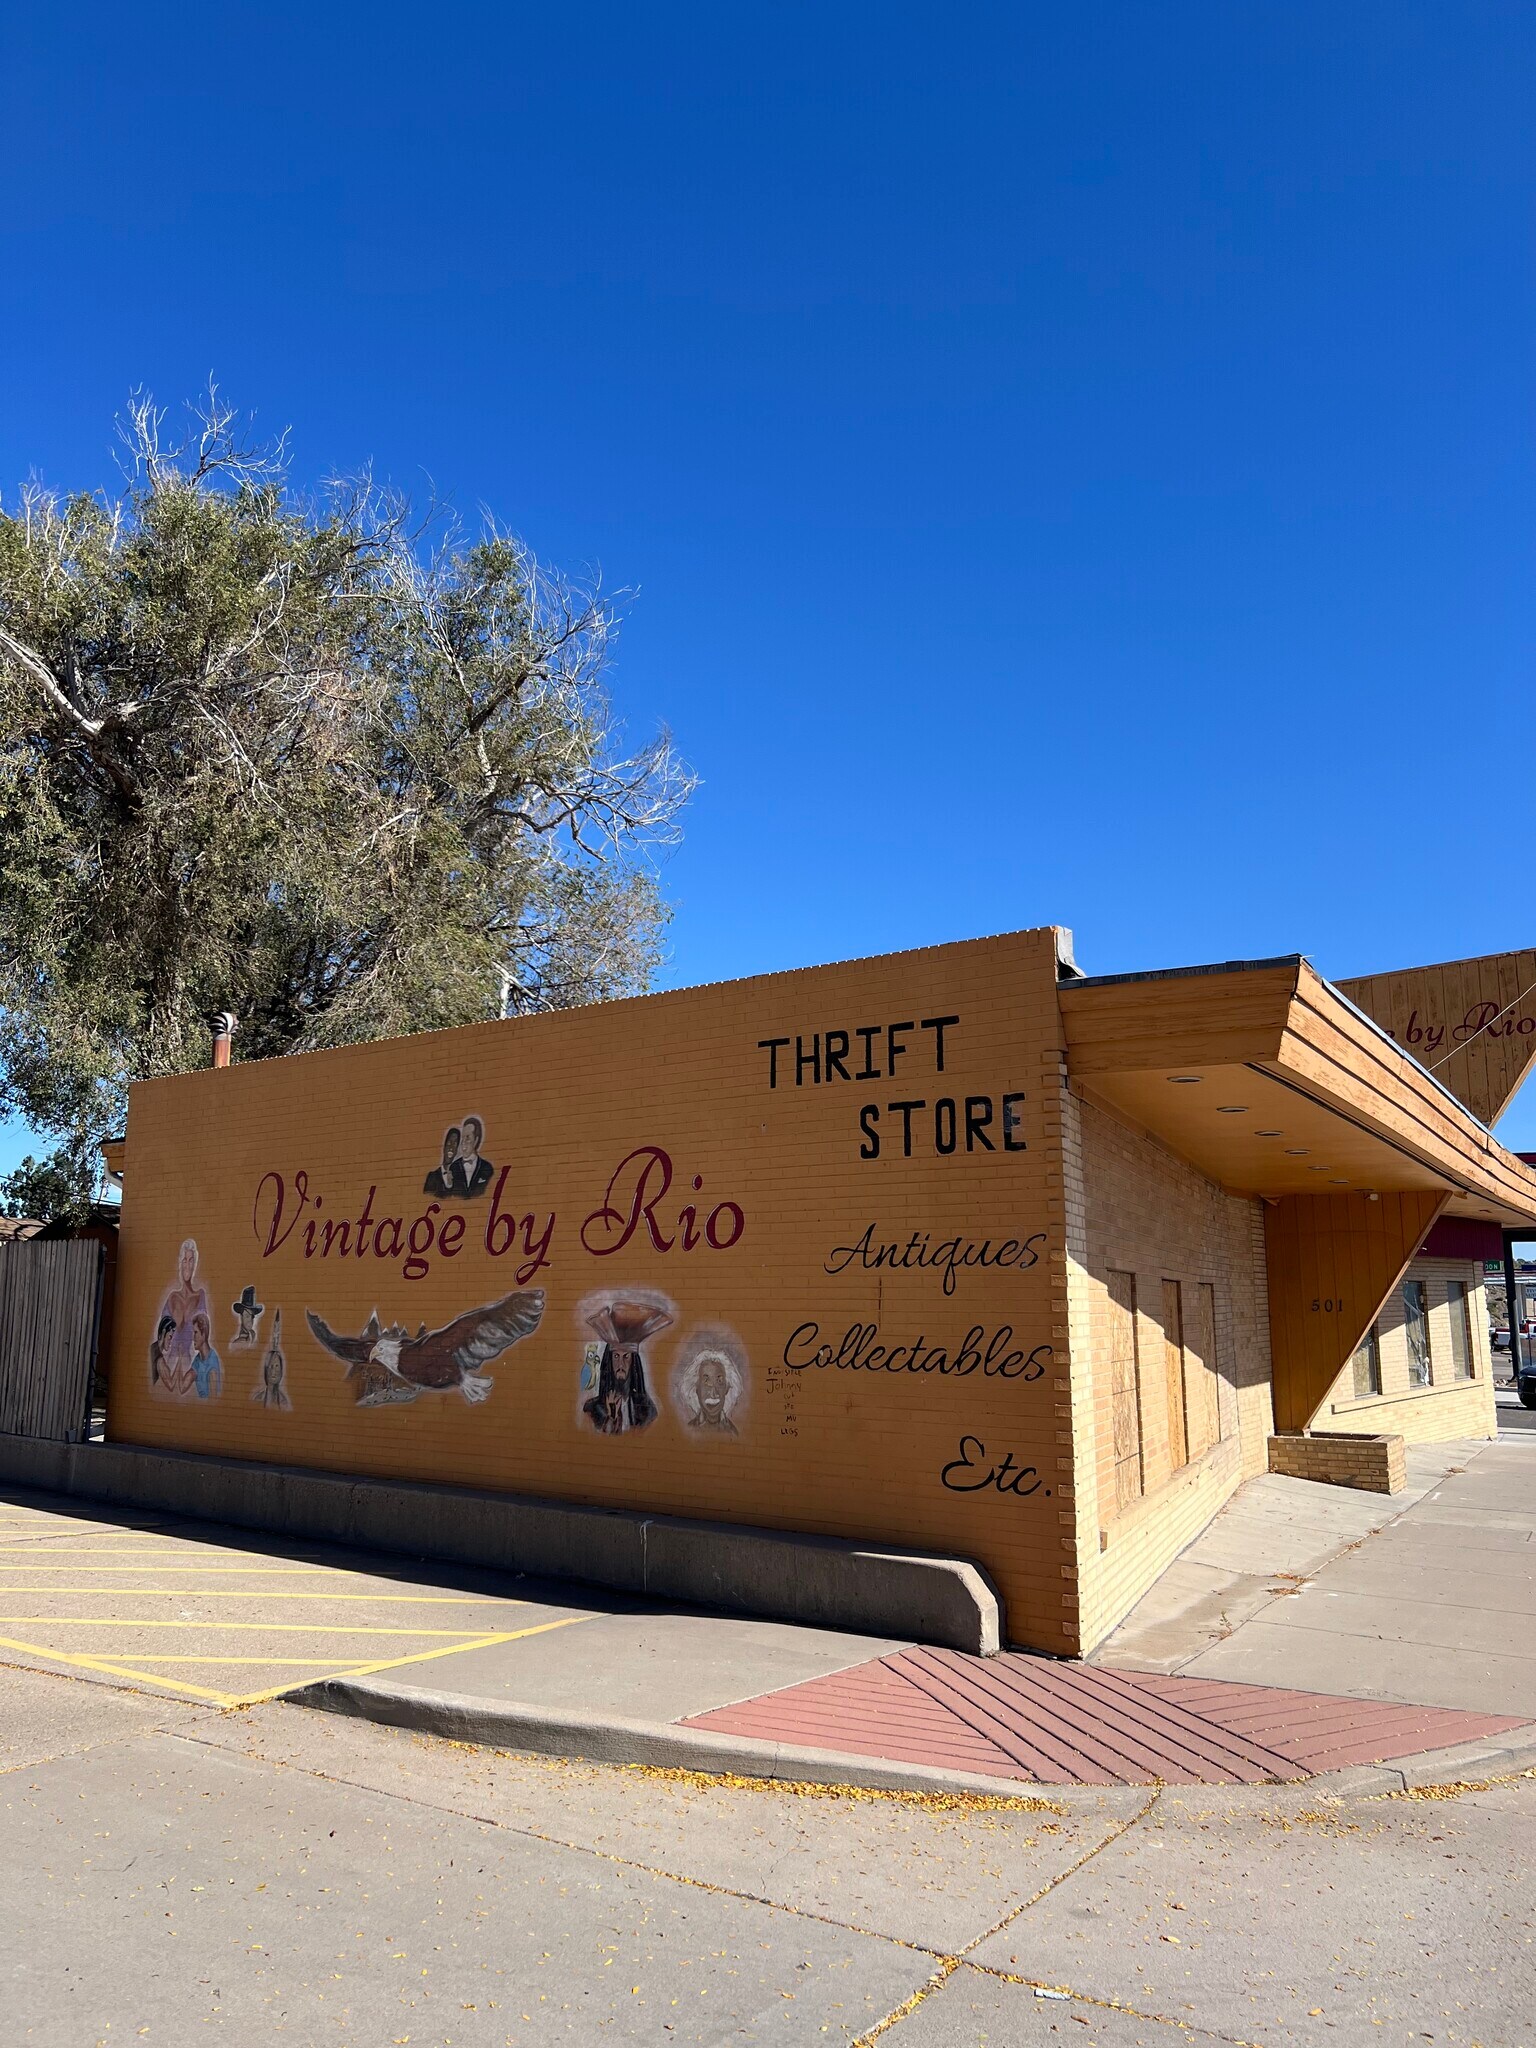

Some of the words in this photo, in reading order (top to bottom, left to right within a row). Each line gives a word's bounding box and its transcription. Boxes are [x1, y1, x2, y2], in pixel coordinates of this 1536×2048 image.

[757, 1014, 960, 1088] THRIFT
[1406, 1011, 1444, 1053] by
[1452, 1001, 1536, 1042] Rio
[860, 1092, 1027, 1159] STORE
[253, 1170, 466, 1280] Vintage
[484, 1165, 555, 1286] by
[580, 1146, 745, 1255] Rio
[823, 1223, 1048, 1296] Antiques
[1311, 1298, 1344, 1313] 501
[783, 1322, 1053, 1382] Collectables
[941, 1435, 1052, 1497] Etc.
